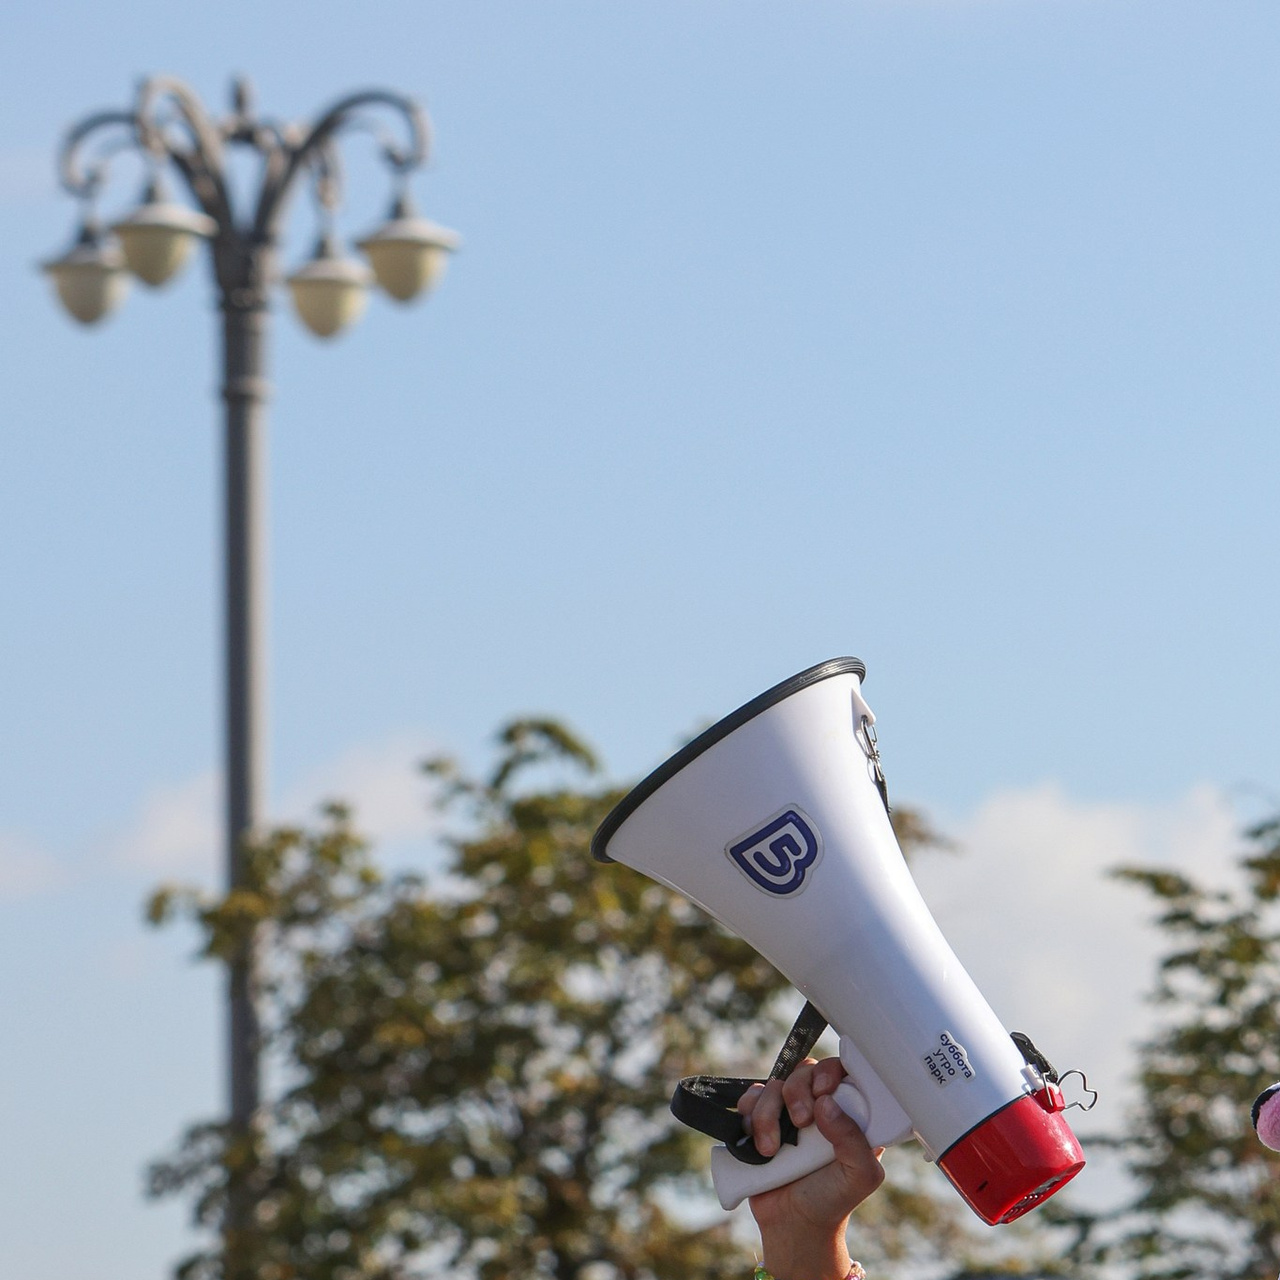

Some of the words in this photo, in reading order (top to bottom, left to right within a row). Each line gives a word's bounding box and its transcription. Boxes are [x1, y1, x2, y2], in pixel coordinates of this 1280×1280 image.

[932, 1048, 956, 1076] утро
[940, 1033, 972, 1078] суббота
[924, 1056, 947, 1084] парк
